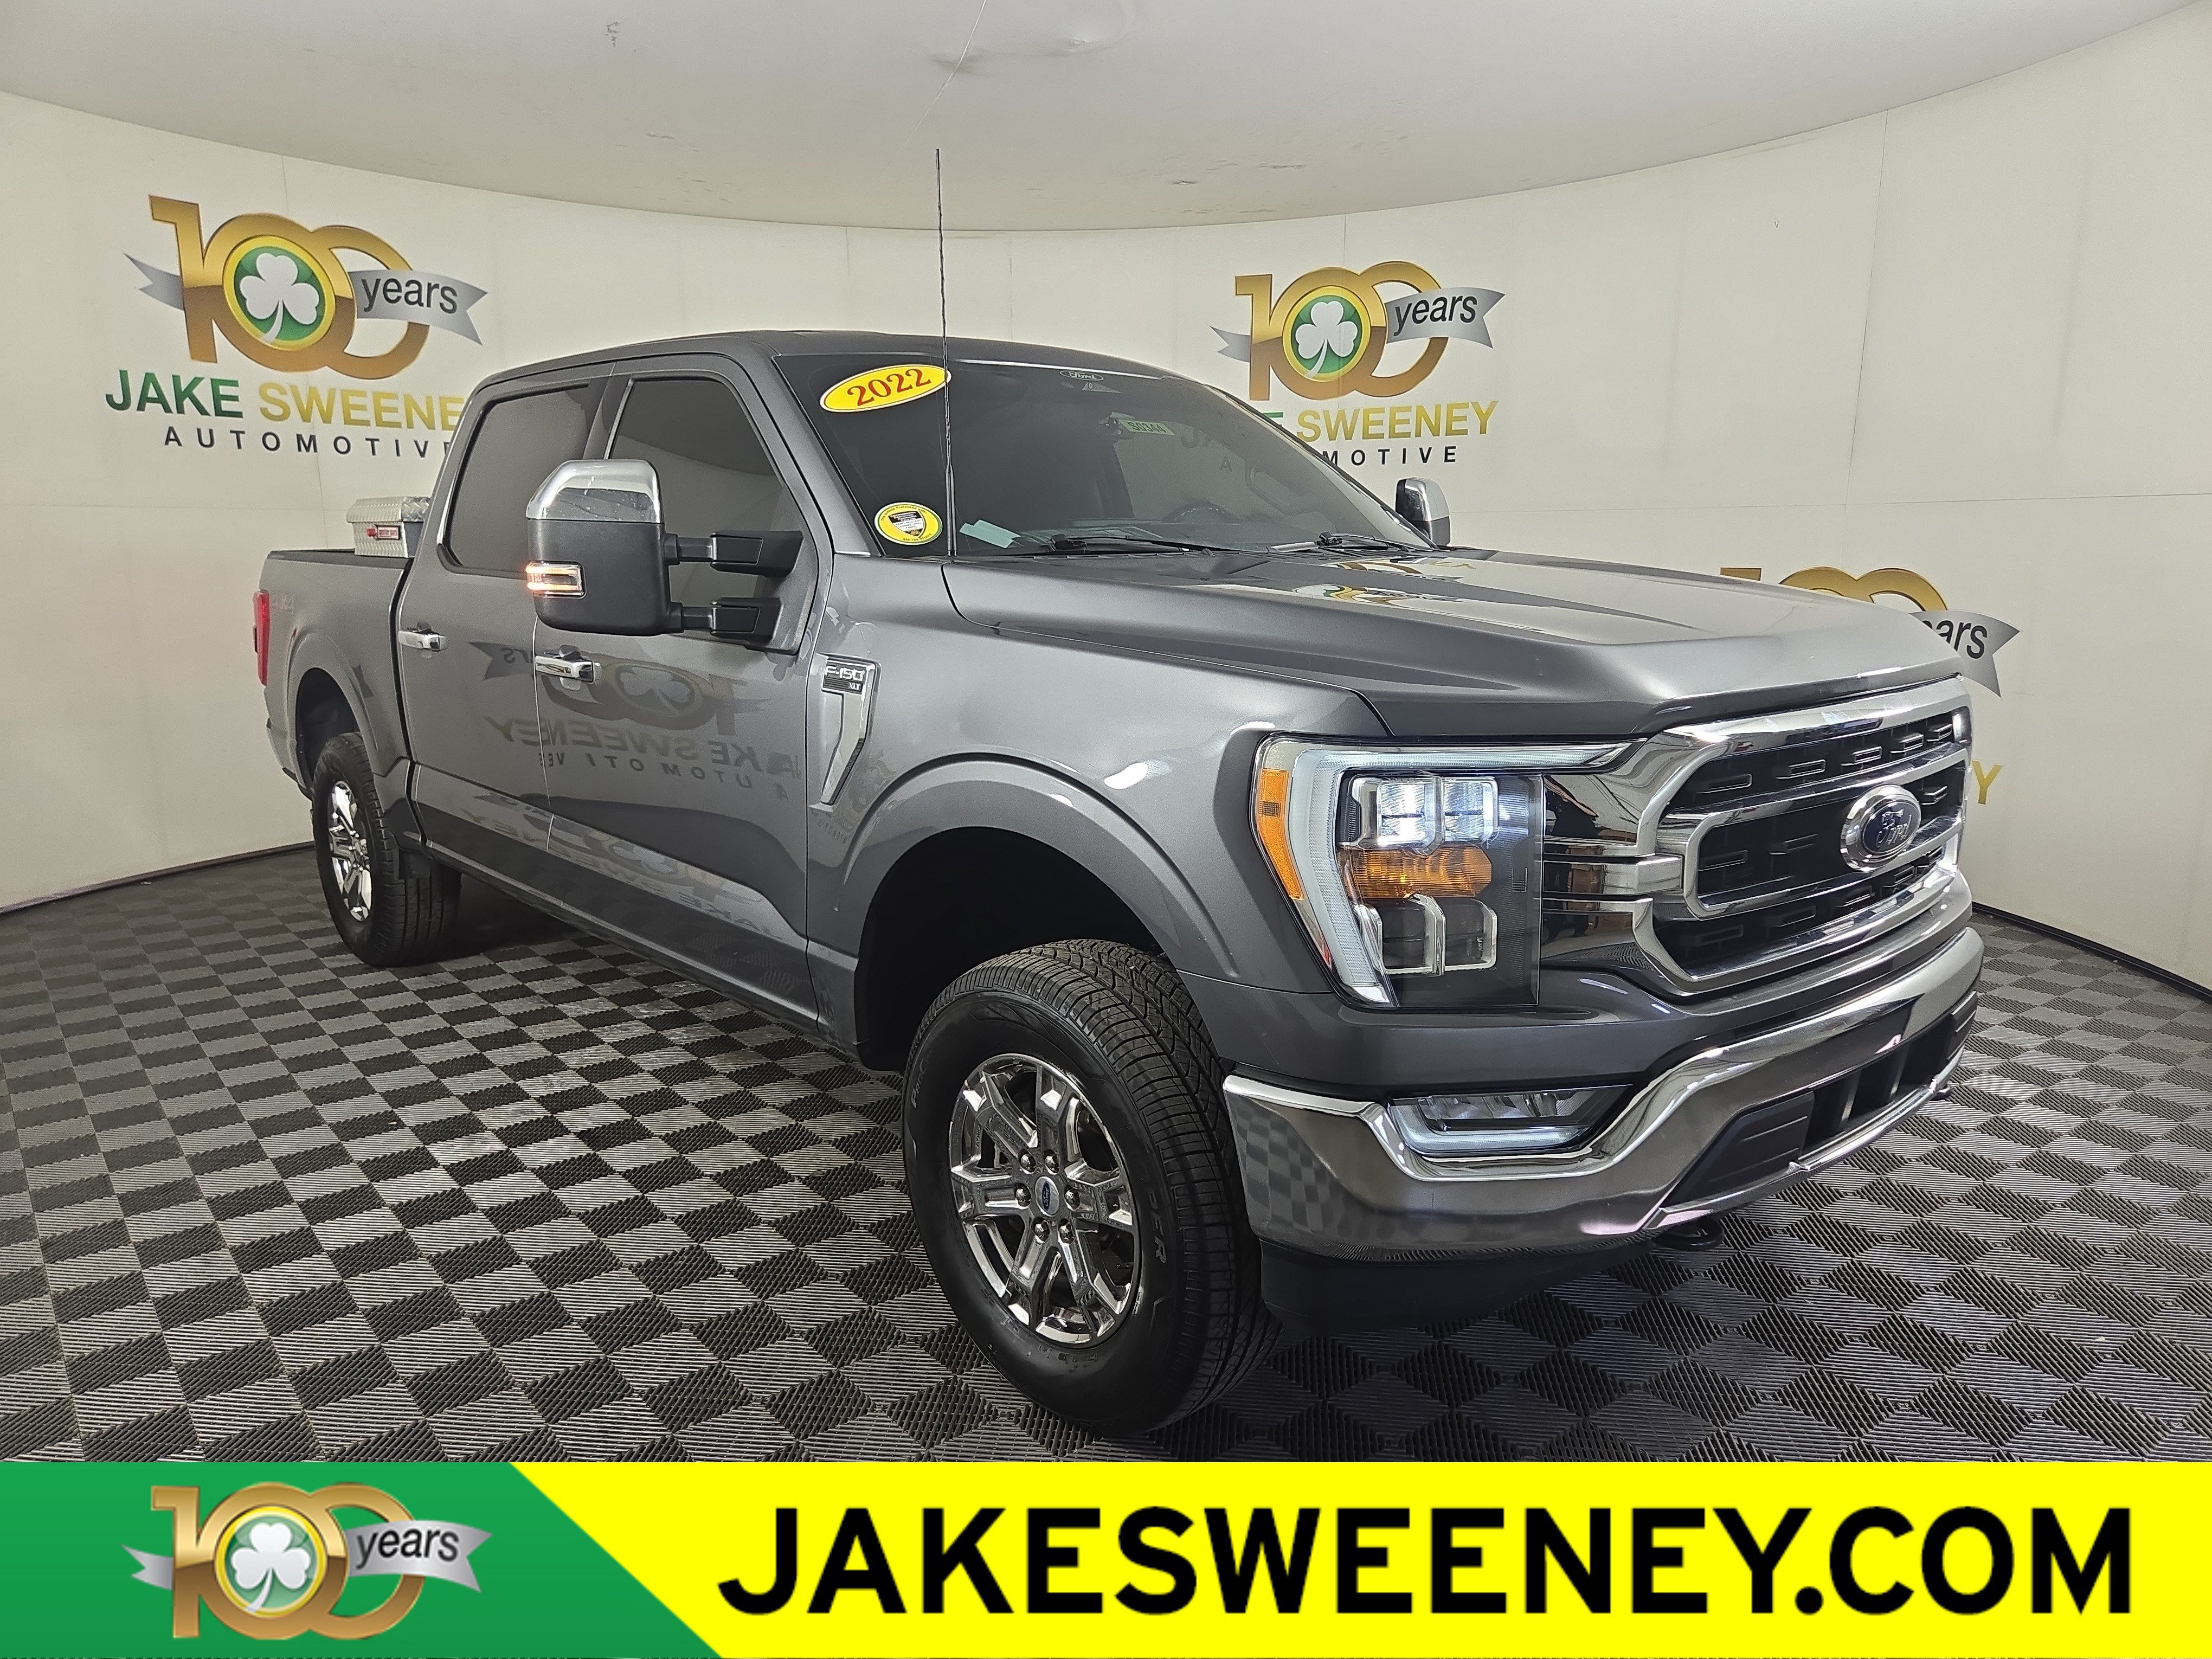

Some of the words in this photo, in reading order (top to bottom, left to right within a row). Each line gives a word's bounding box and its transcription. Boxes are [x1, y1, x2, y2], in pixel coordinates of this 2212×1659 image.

[148, 194, 430, 380] 100
[360, 276, 459, 314] years
[1234, 261, 1449, 401] 100
[1392, 293, 1478, 337] years
[105, 369, 244, 420] JAKE
[258, 382, 467, 433] SWEENE
[847, 368, 932, 407] 2022
[1296, 400, 1499, 443] SWEENEY
[1321, 445, 1457, 466] MOTIVE
[824, 665, 866, 682] F-150
[848, 682, 861, 691] XLT
